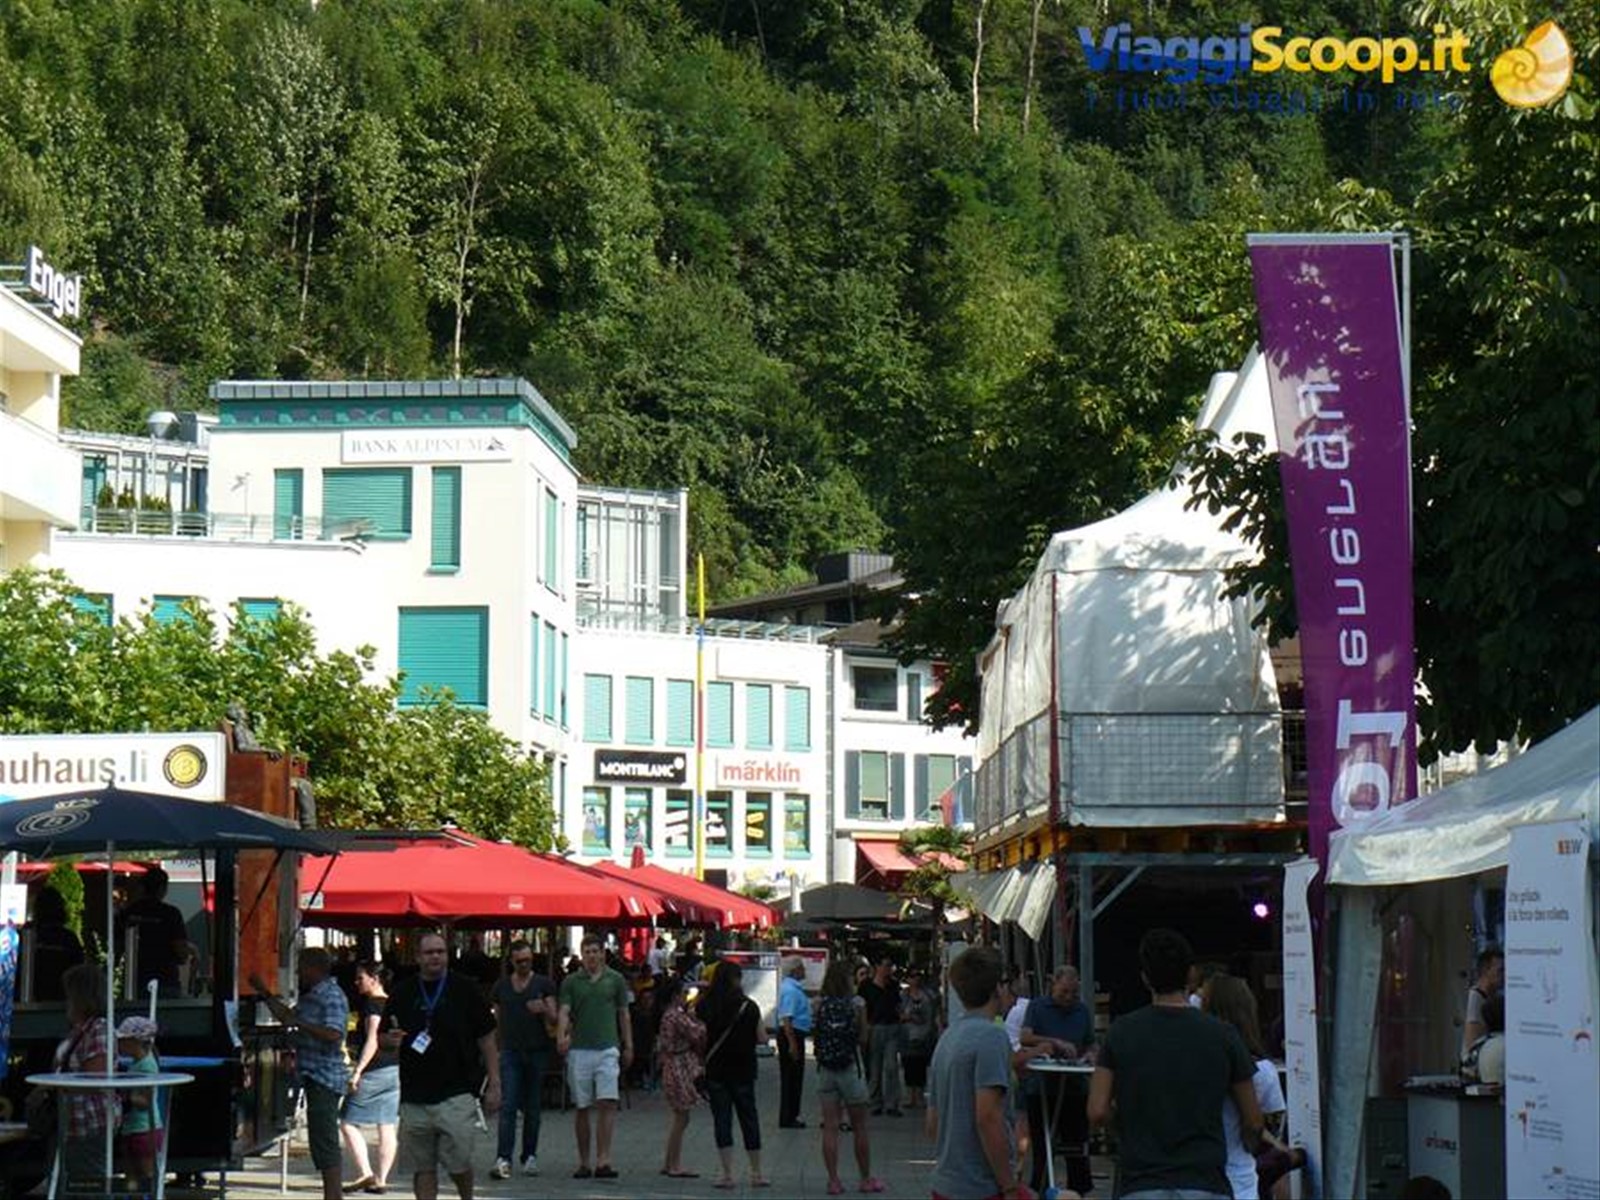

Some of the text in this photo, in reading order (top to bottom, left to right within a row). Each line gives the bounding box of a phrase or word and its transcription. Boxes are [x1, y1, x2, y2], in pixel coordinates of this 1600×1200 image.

[29, 245, 81, 319] Engel
[351, 438, 483, 452] BANK ALPINUM
[0, 750, 149, 785] uhaus.li
[600, 761, 675, 778] MONTBLANC
